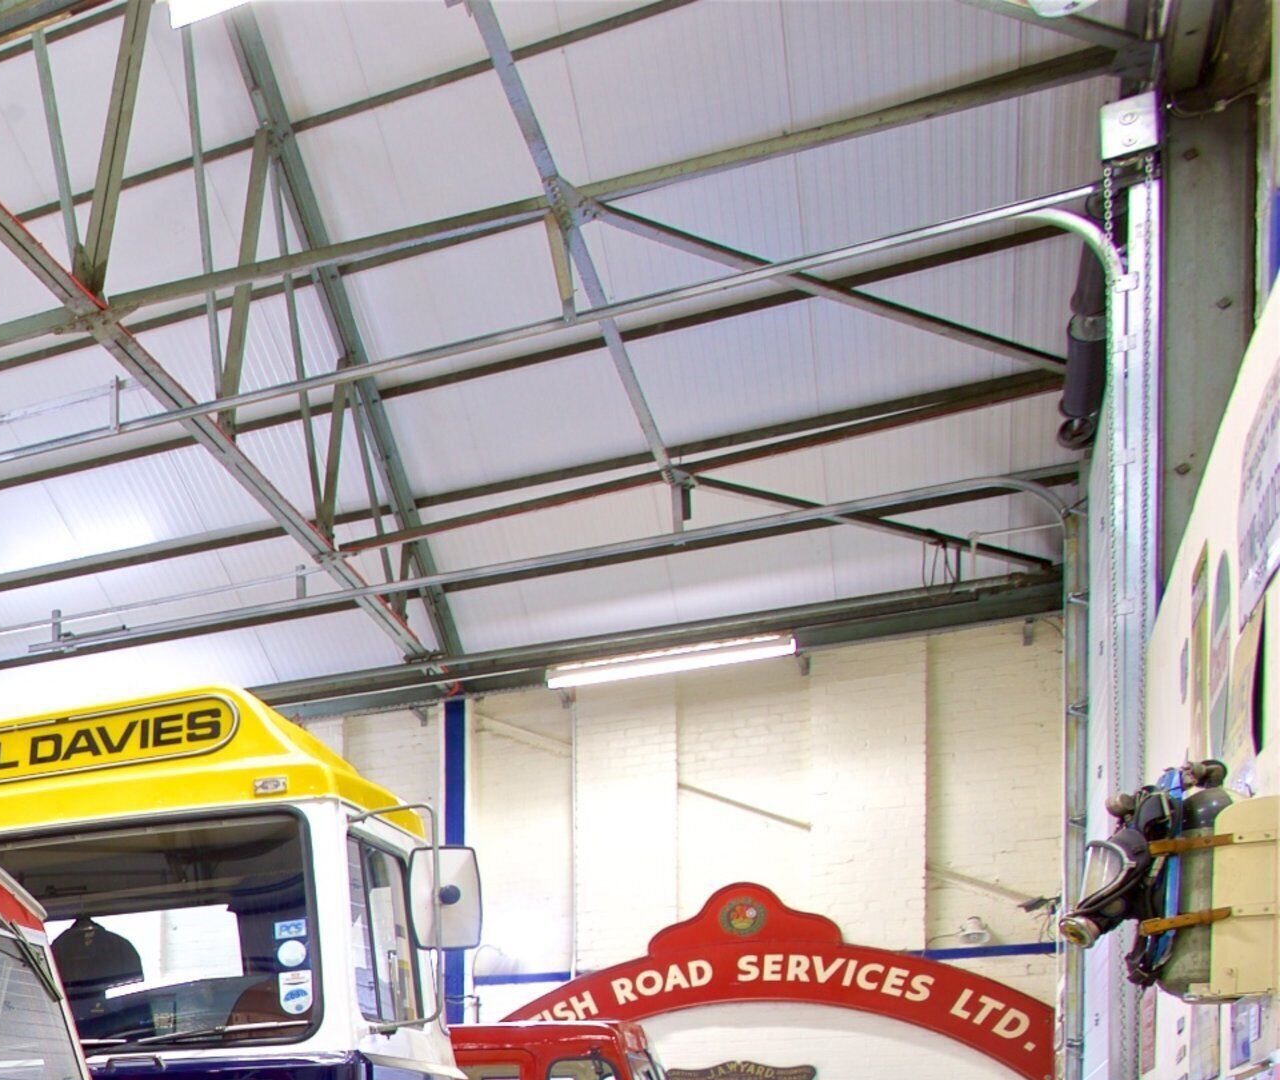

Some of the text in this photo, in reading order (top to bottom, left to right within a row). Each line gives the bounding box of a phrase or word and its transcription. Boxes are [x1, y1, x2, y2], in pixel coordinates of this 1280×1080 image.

[29, 708, 222, 766] DAVIES
[611, 960, 713, 1004] ROAD
[737, 954, 934, 1002] SERVICES
[950, 989, 1037, 1051] LTD.
